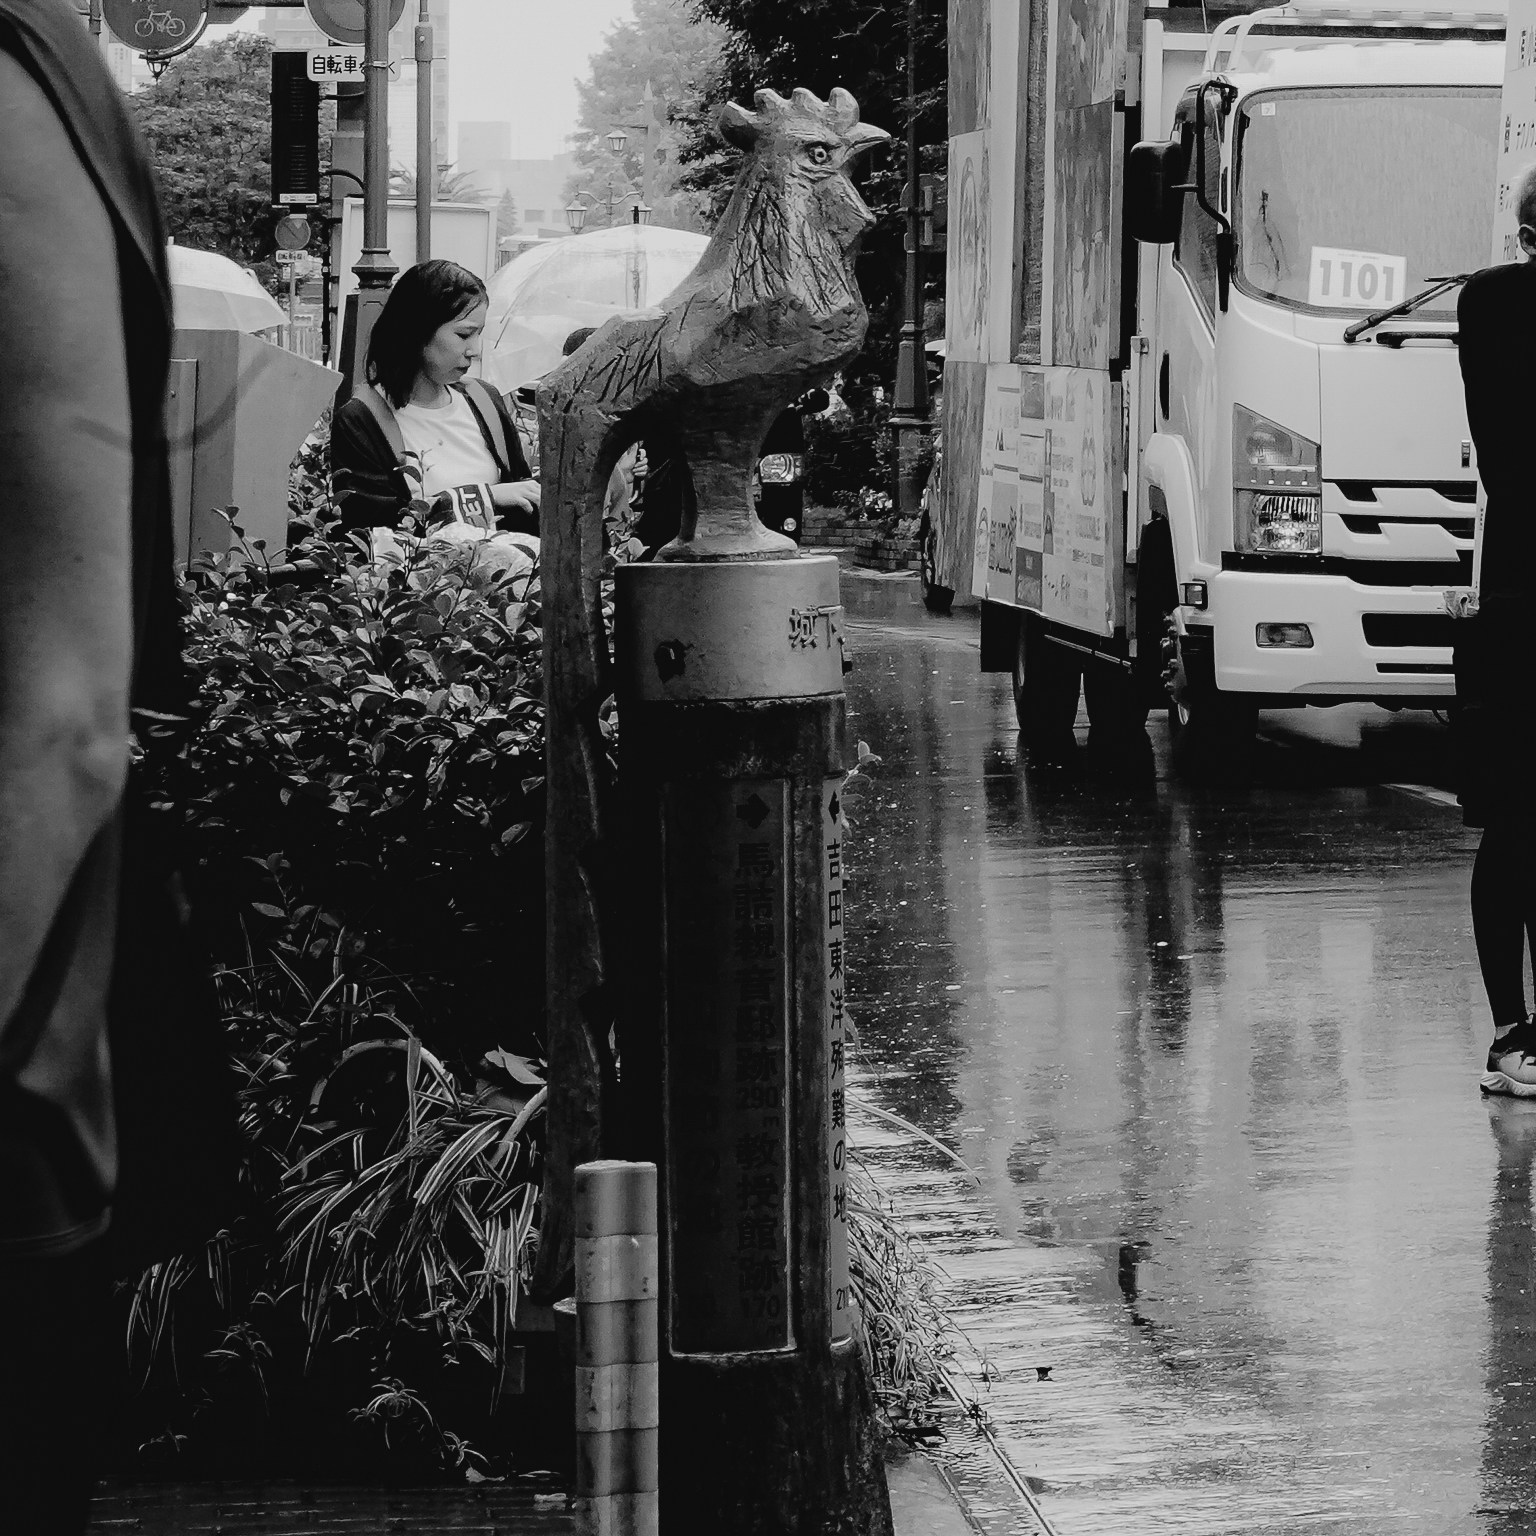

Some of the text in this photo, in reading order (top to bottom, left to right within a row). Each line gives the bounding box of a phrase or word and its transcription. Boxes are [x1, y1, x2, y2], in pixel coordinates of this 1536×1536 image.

[1320, 259, 1394, 301] 1101
[735, 1131, 779, 1292] 教授館跡
